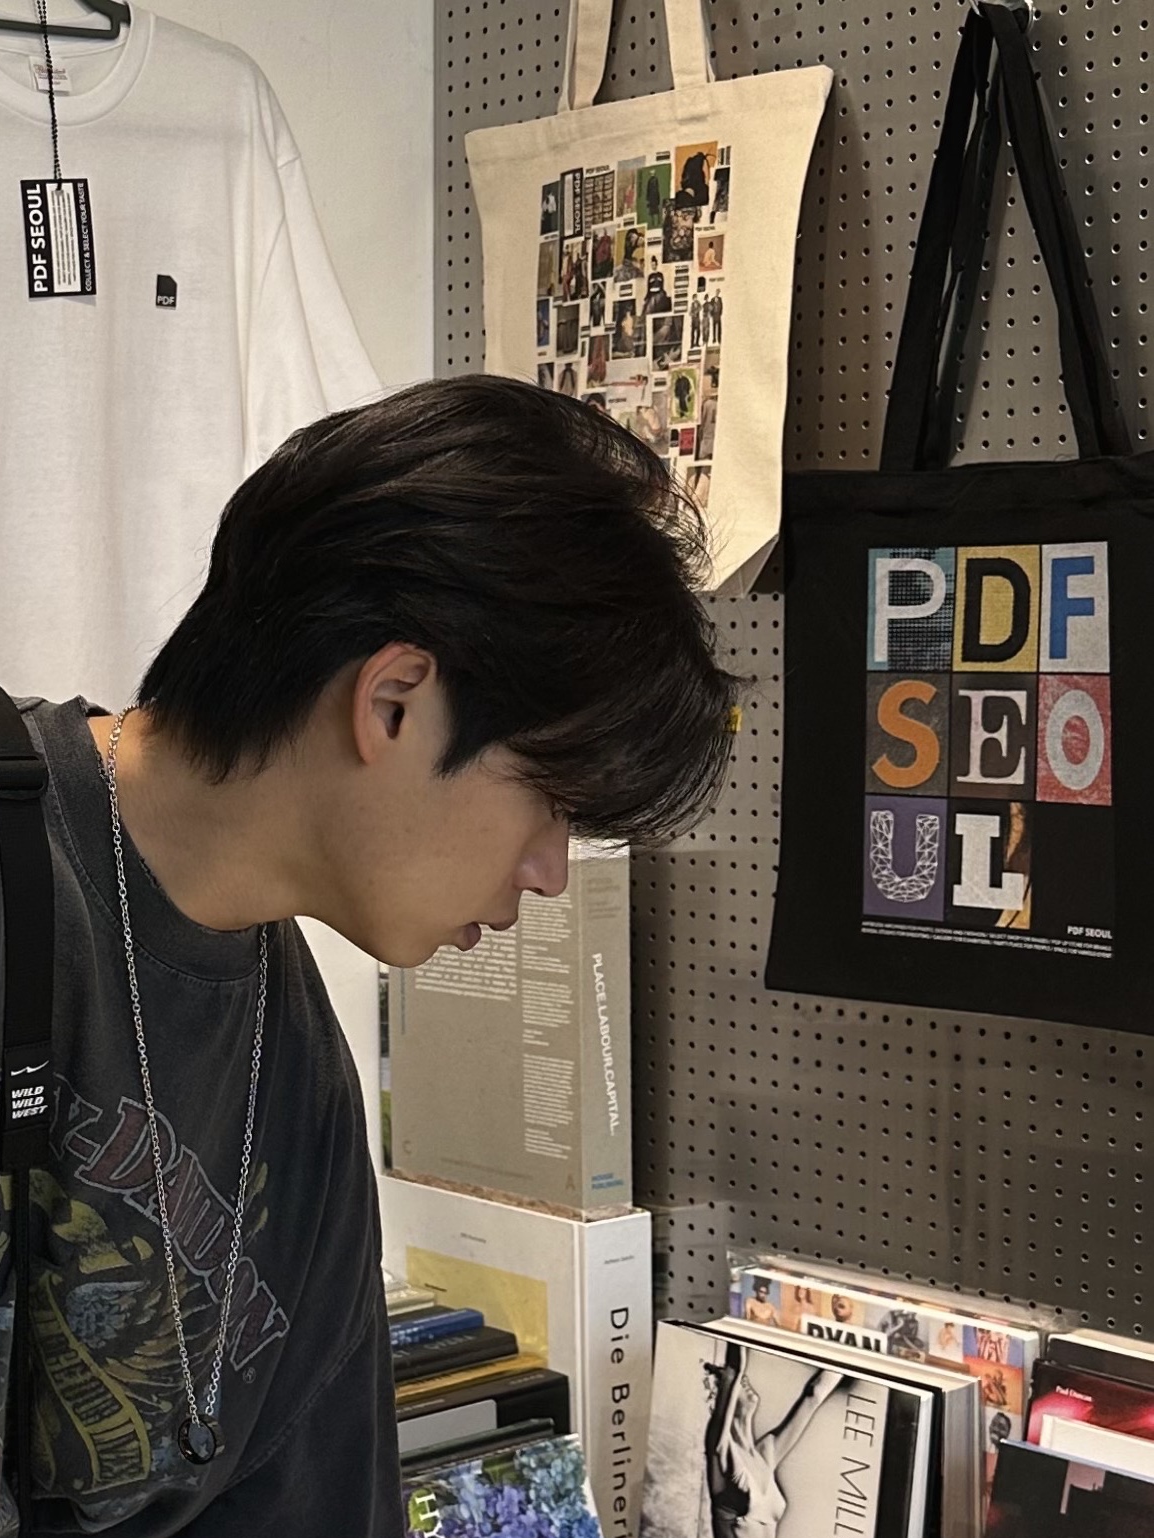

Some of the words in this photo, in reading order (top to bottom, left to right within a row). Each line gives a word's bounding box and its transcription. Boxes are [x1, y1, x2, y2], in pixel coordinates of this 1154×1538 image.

[26, 183, 46, 250] SEOUL
[32, 253, 49, 292] PDF
[157, 295, 175, 306] PDF
[873, 555, 1095, 663] PDF
[871, 679, 1105, 791] SEO
[869, 809, 1025, 912] UL
[1067, 925, 1084, 936] PDF
[1085, 928, 1113, 939] SEOUL
[11, 1085, 45, 1099] WILD
[11, 1096, 45, 1109] WILD
[11, 1105, 48, 1119] WEST
[610, 1306, 630, 1364] Die
[843, 1393, 877, 1448] LEE
